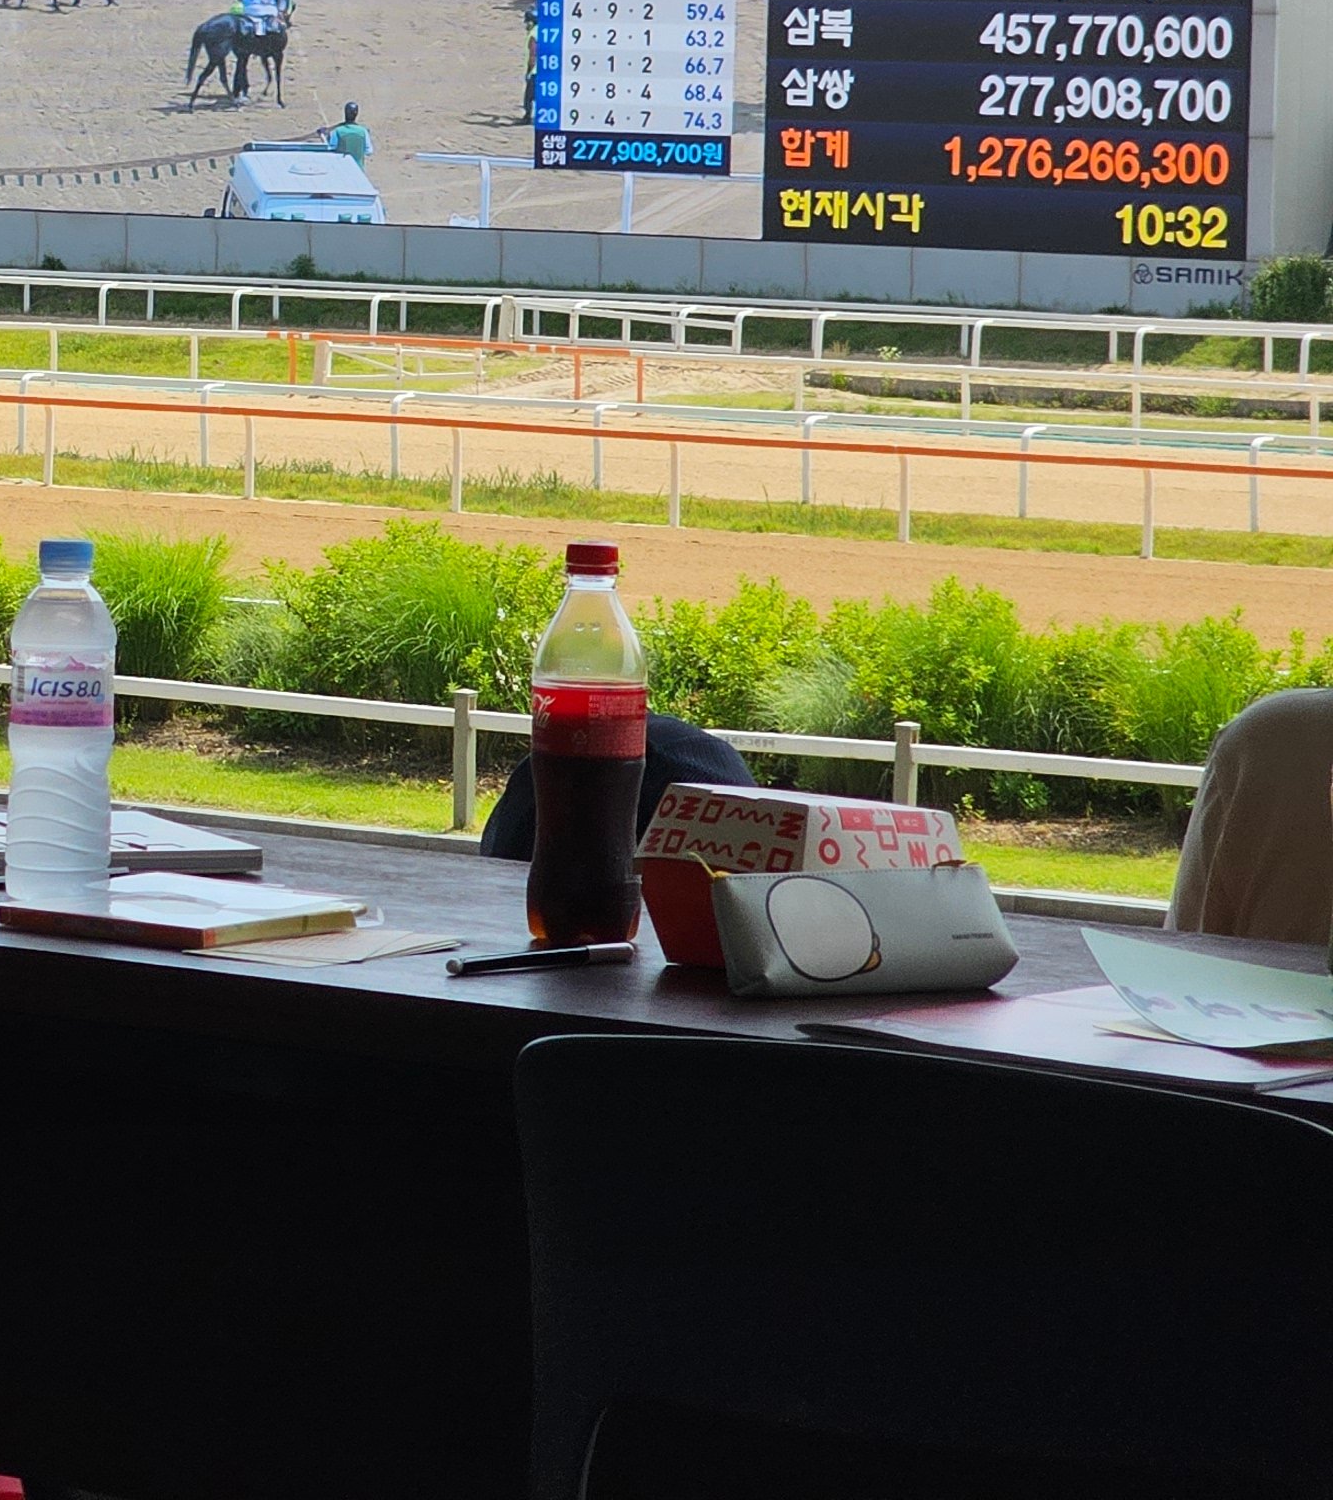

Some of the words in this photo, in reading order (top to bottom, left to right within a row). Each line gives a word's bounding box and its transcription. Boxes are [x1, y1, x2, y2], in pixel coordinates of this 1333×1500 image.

[783, 7, 853, 47] 삼복
[980, 13, 1232, 63] 457,770,600
[685, 58, 724, 75] 66.7
[683, 111, 722, 129] 74.3
[781, 68, 855, 109] 삼쌍
[979, 74, 1231, 126] 277,908,700
[781, 128, 849, 168] 합계
[945, 136, 1229, 188] 1,276,266,300
[780, 189, 924, 232] 현재시각
[1116, 204, 1227, 248] 10:32
[1156, 267, 1243, 285] SAMIK
